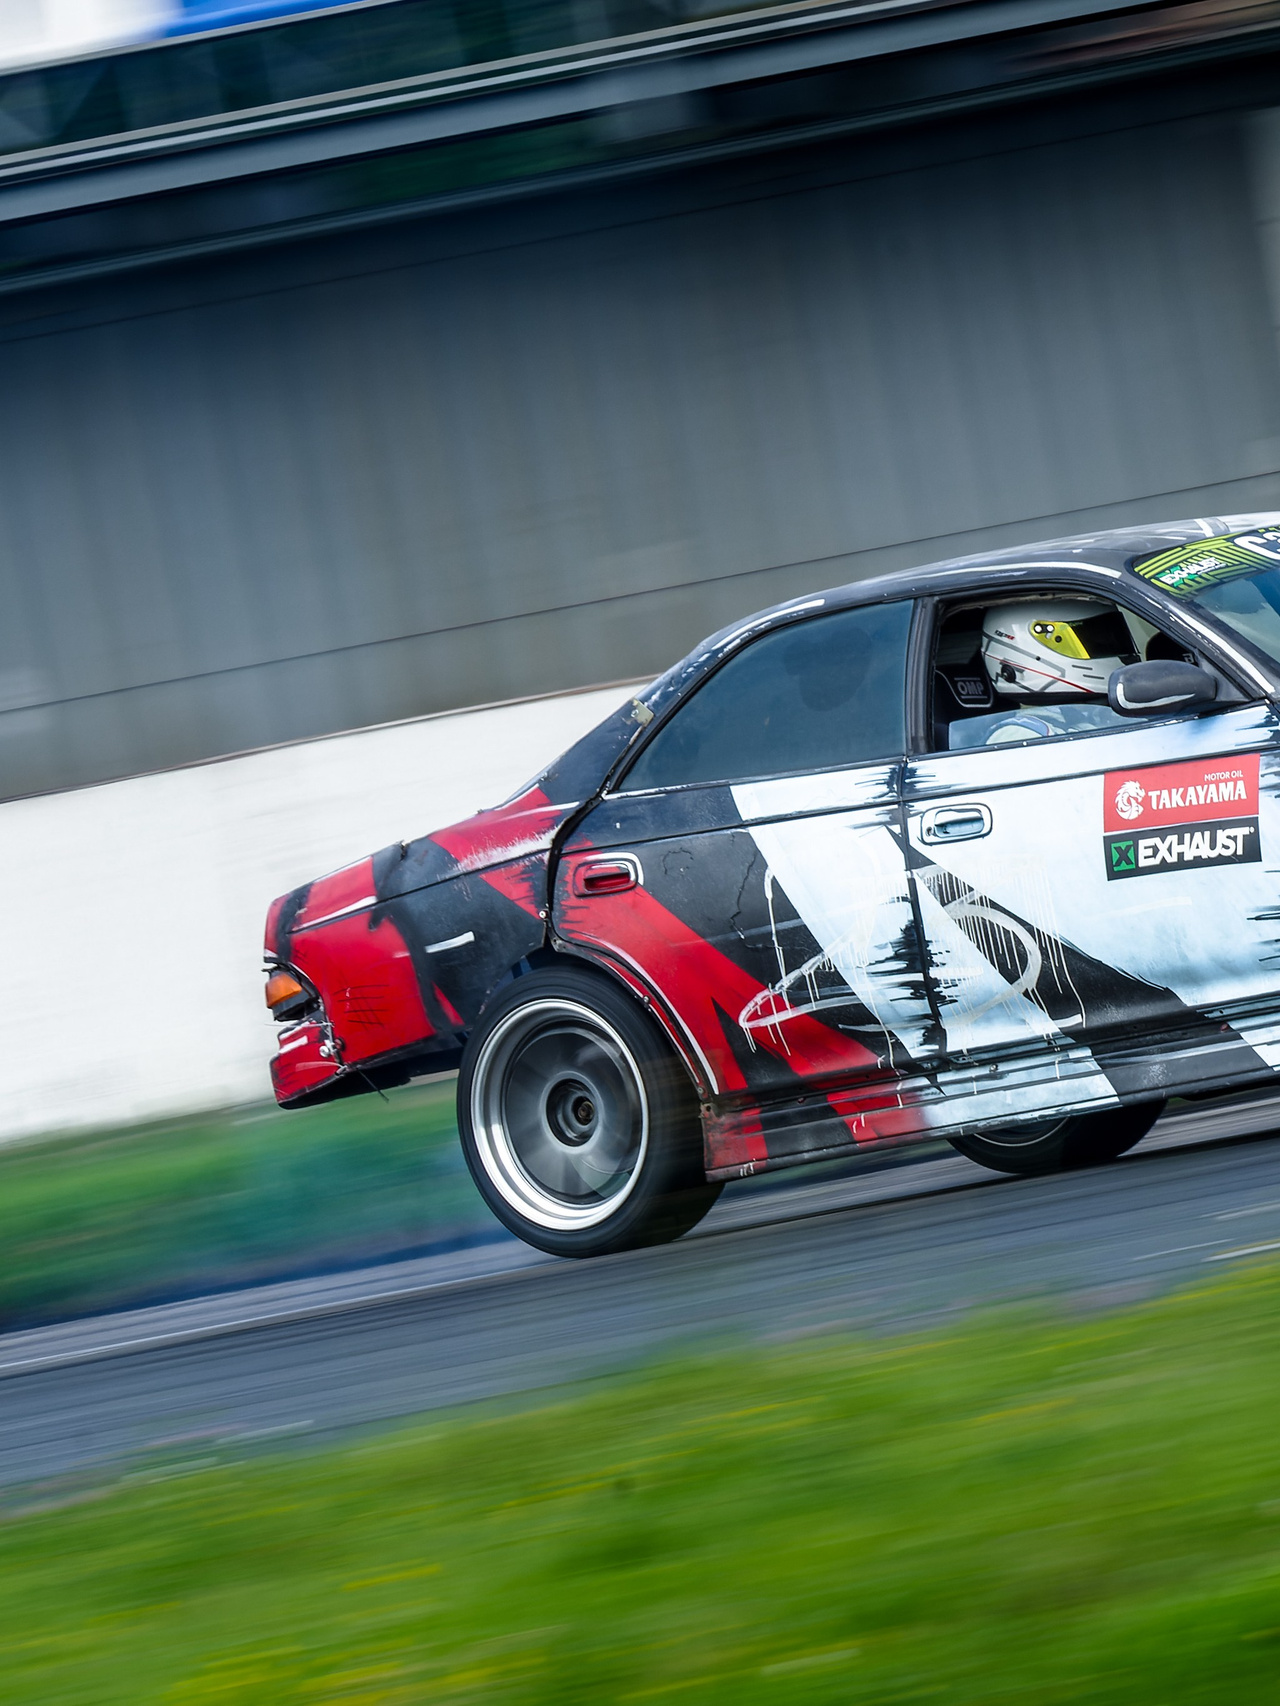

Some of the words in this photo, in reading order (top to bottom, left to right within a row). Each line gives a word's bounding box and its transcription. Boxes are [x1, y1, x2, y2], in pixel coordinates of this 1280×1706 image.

[957, 681, 985, 696] OMP
[1204, 770, 1231, 782] MOTOR
[1231, 769, 1244, 779] OIL
[1147, 780, 1248, 811] TAKAYAMA
[1137, 826, 1250, 868] EXHAUST
